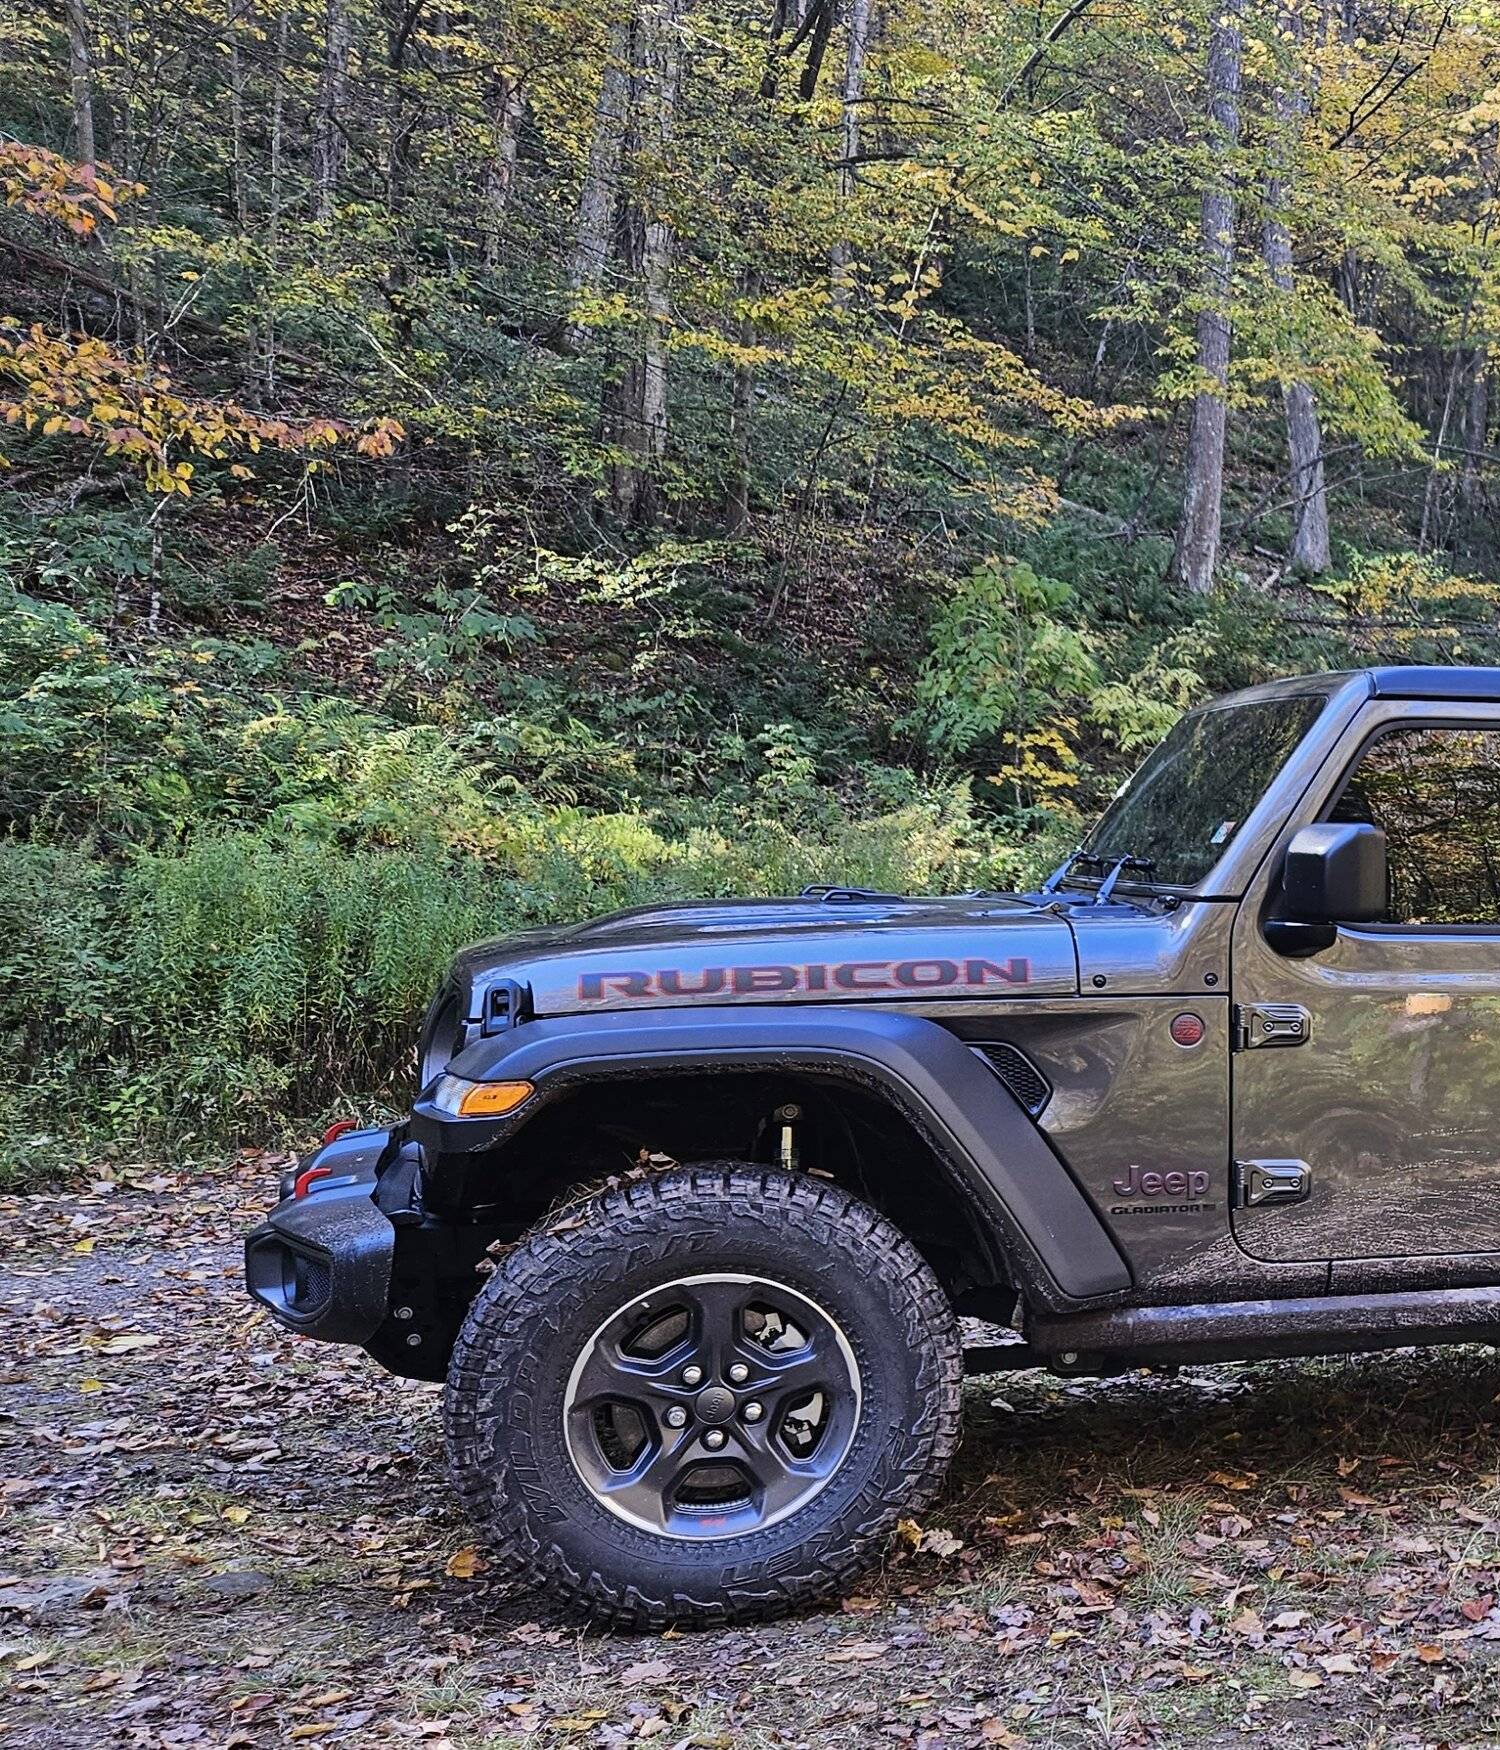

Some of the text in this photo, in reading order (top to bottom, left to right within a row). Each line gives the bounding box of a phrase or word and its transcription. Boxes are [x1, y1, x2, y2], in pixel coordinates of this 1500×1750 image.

[577, 957, 1030, 1000] RUBICON
[1113, 1165, 1209, 1200] Jeep
[1111, 1204, 1200, 1215] GLADIATOR
